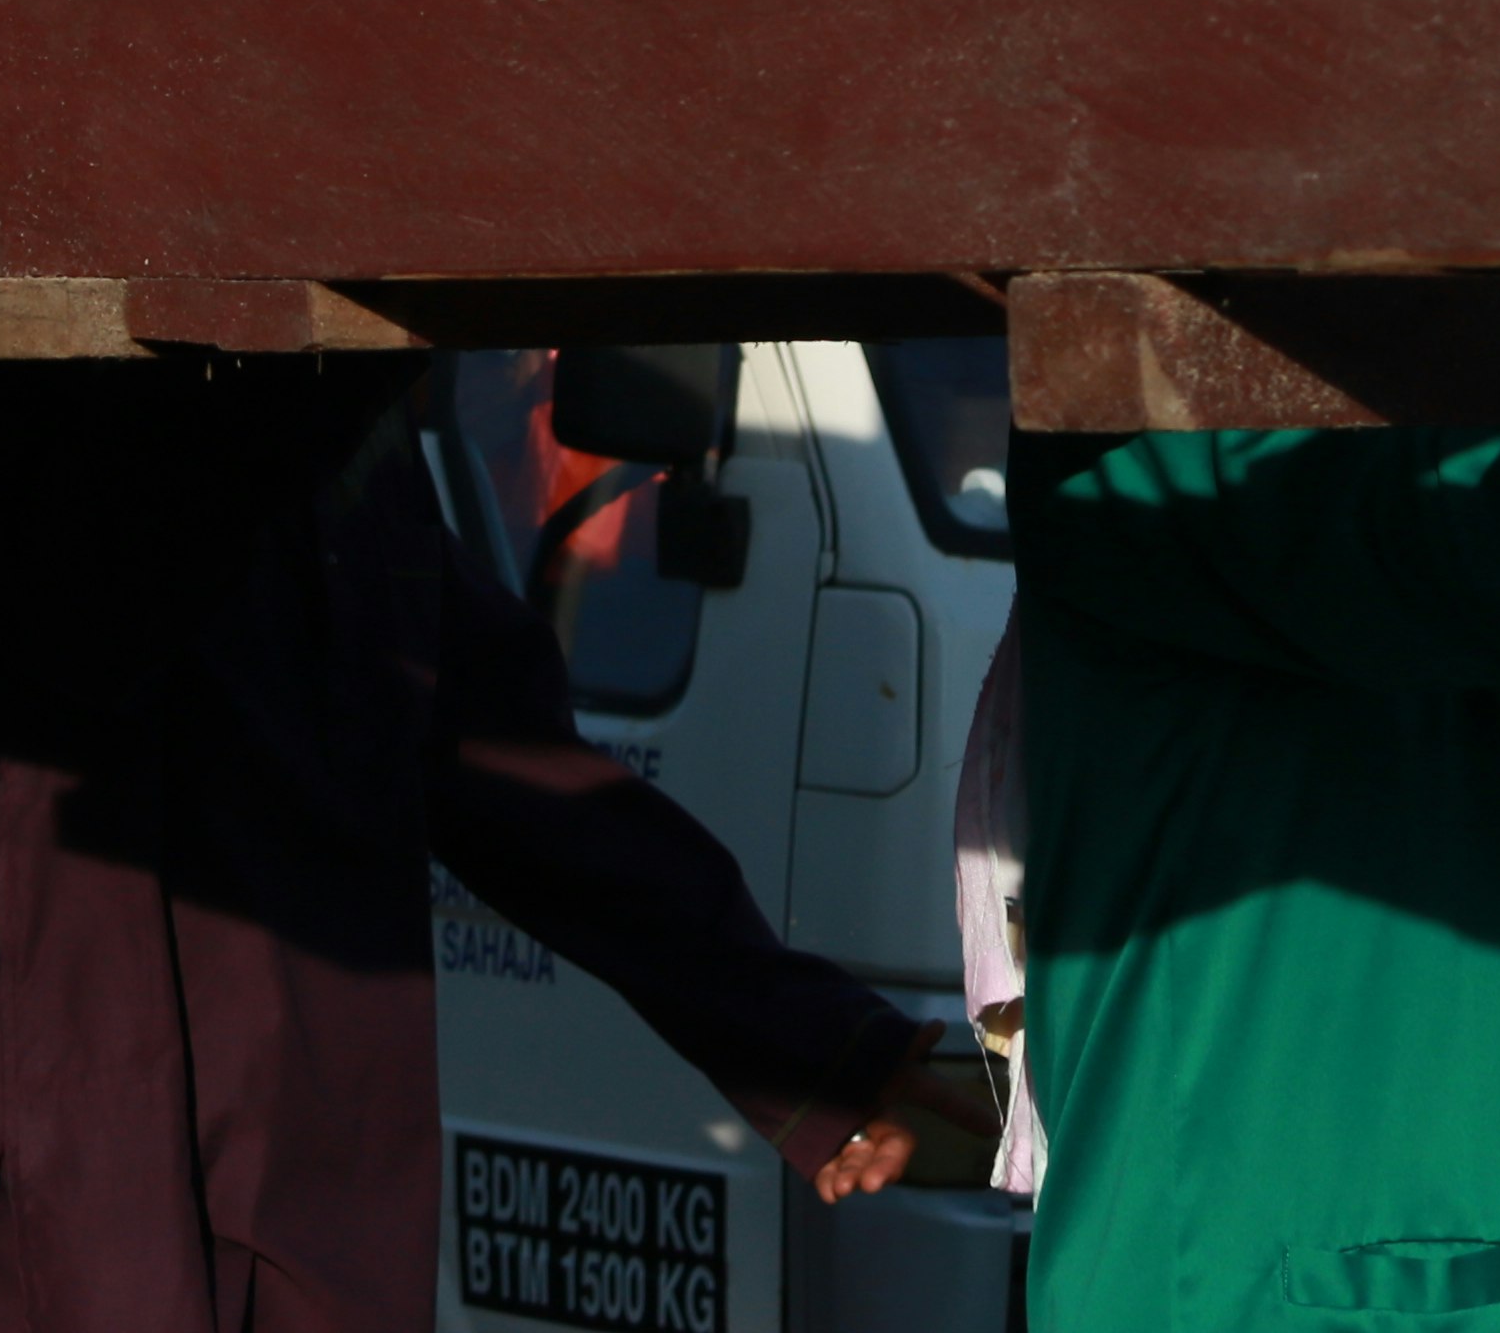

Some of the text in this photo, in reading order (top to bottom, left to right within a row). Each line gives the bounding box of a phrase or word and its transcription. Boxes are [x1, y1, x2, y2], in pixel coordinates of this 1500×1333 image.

[440, 920, 556, 984] SAHAJA
[463, 1147, 716, 1257] BDM 2400 KG
[466, 1225, 717, 1333] BTM 1500 KG
